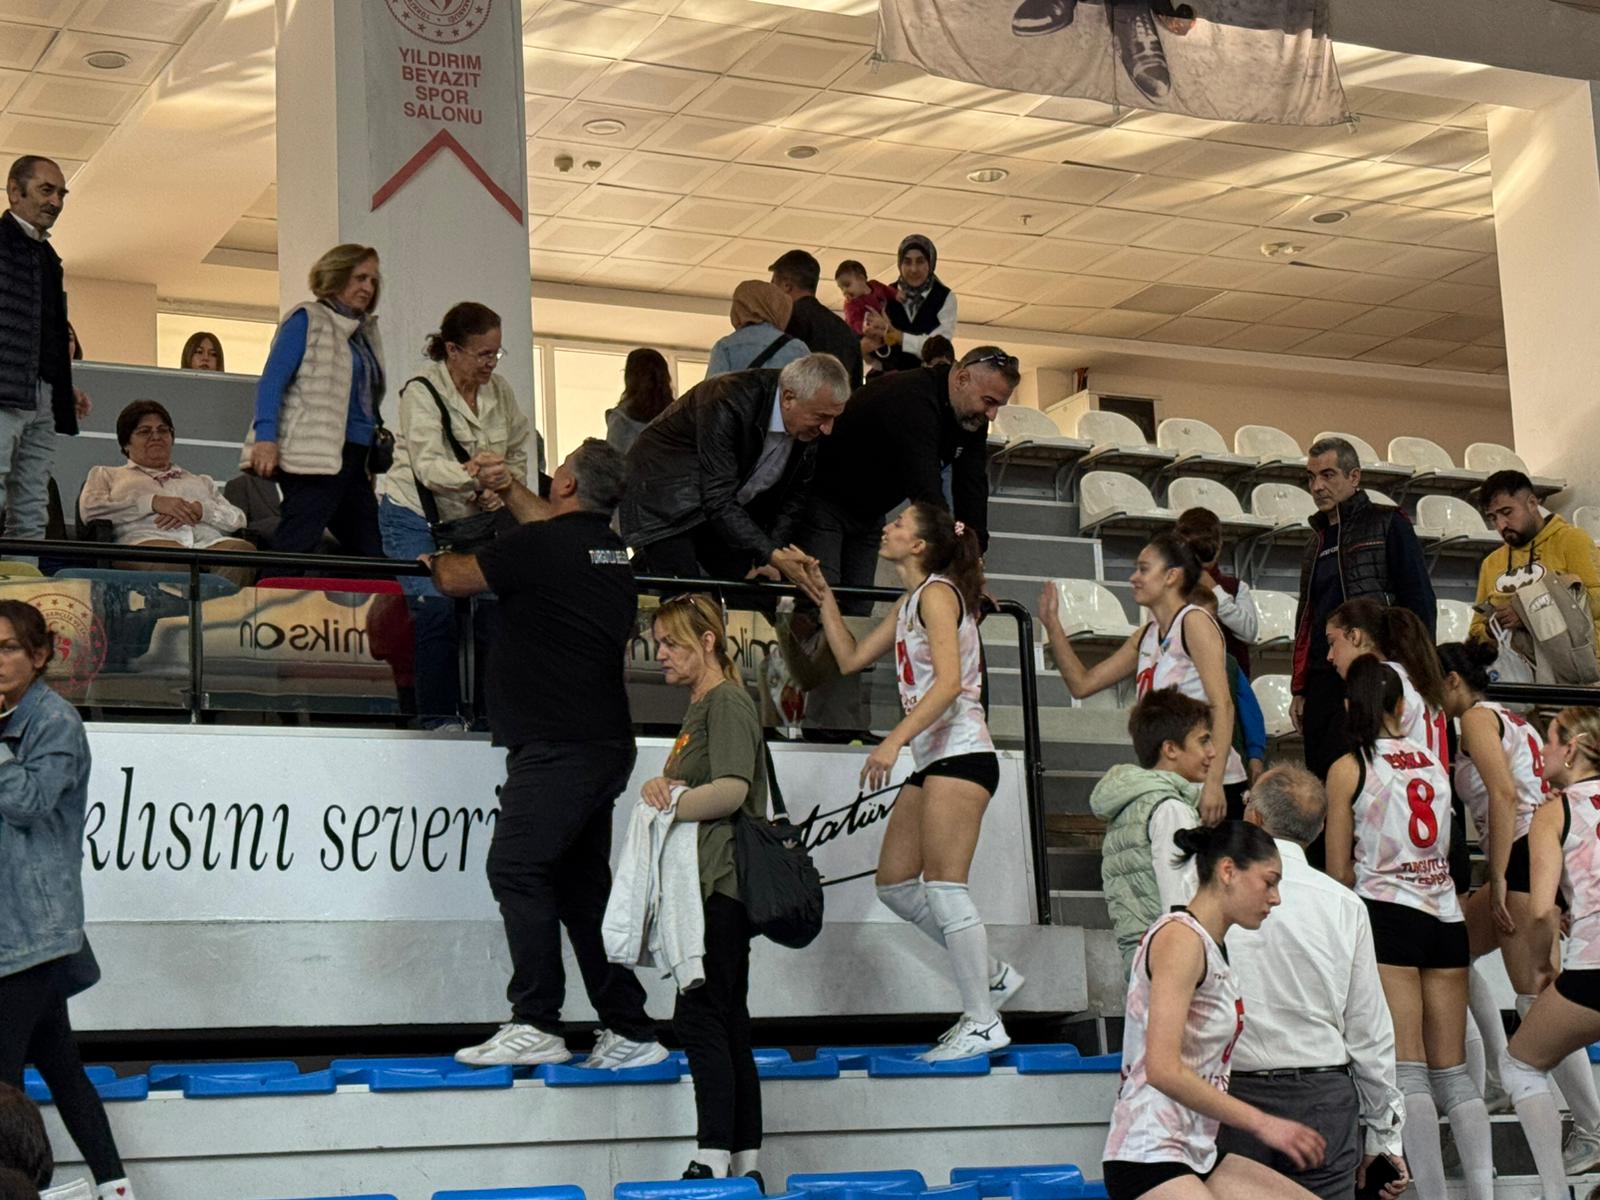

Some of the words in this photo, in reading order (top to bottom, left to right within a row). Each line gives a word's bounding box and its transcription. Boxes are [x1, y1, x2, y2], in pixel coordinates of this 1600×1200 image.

[399, 47, 482, 71] YILDIRIM
[402, 66, 481, 88] BEYAZIT
[415, 85, 469, 105] SPOR
[404, 102, 483, 125] SALONU
[1406, 777, 1438, 849] 8
